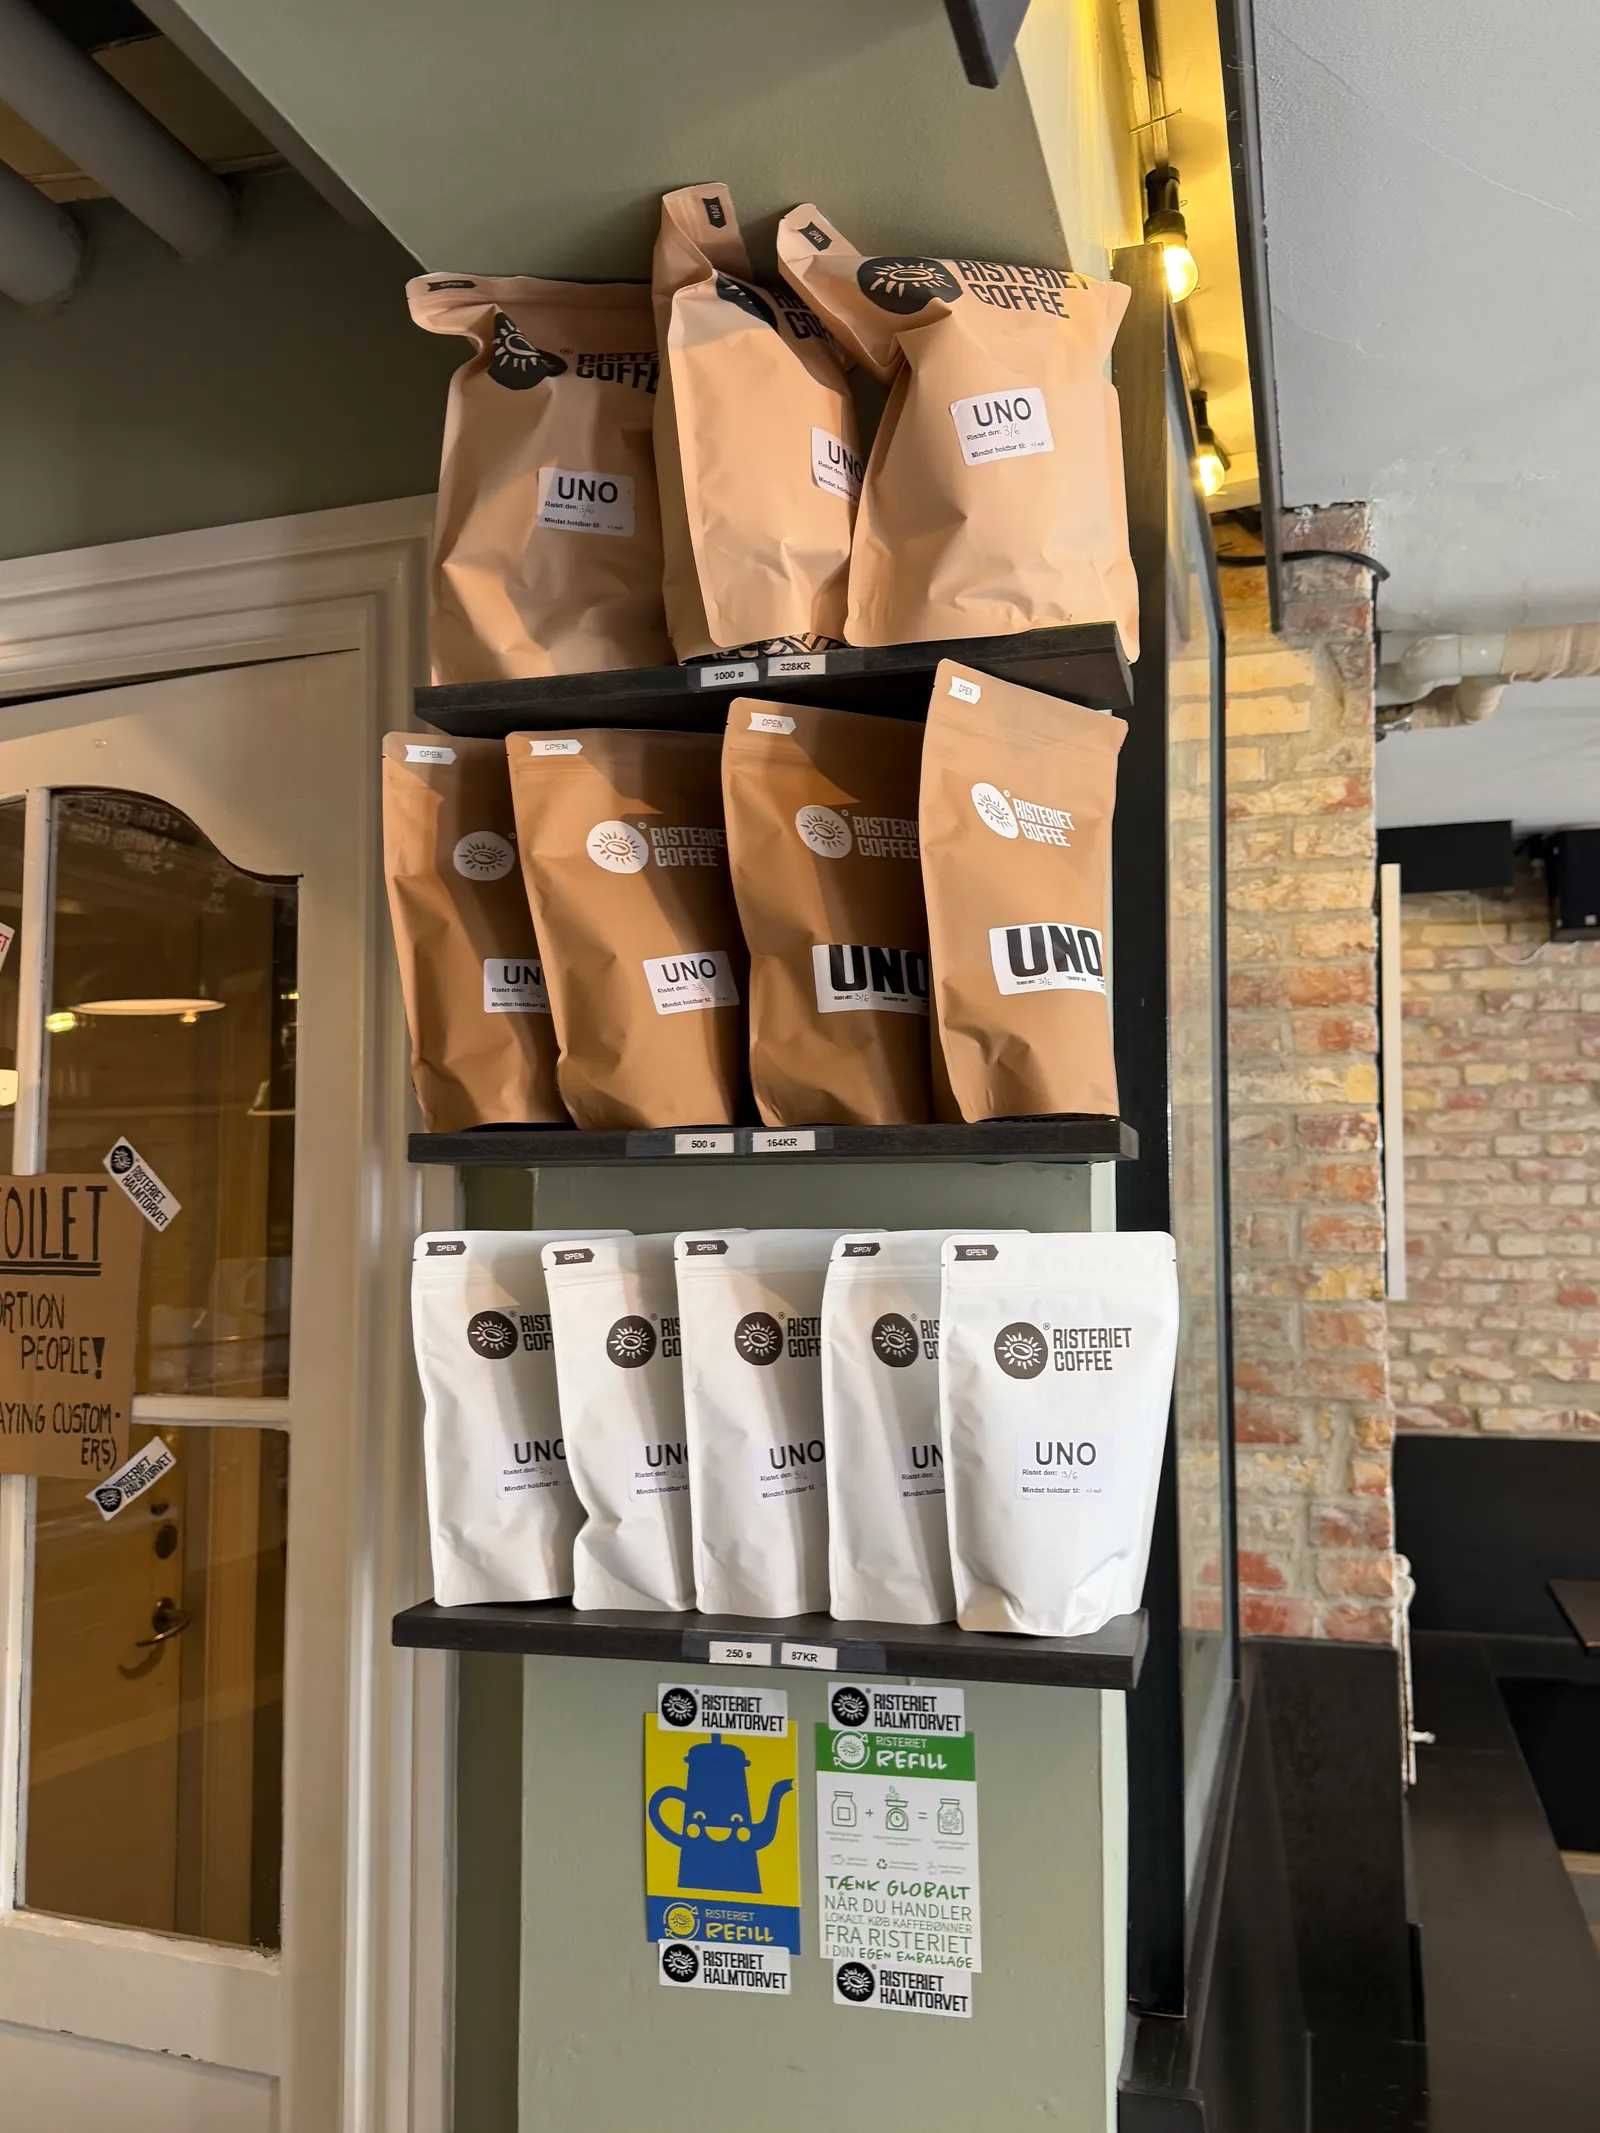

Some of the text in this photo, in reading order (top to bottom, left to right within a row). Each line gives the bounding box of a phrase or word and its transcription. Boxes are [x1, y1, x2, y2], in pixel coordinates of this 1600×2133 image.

[808, 230, 825, 243] OPEN
[968, 283, 1070, 319] COFFEE
[973, 397, 1032, 427] UNO
[1002, 423, 1020, 438] 3/6
[828, 440, 863, 483] UNO
[558, 476, 618, 504] UNO
[713, 671, 736, 681] 1000
[779, 662, 811, 672] 328KR
[959, 684, 974, 697] OPEN
[761, 718, 784, 729] OPEN
[419, 750, 443, 759] OPEN
[544, 743, 569, 751] OPEN
[1012, 797, 1076, 831] RISTERIET
[1019, 820, 1072, 847] COFFEE
[654, 848, 719, 867] COFFEE
[857, 837, 920, 860] COFFEE
[1005, 925, 1104, 978] UNO
[661, 958, 717, 983] UNO
[828, 944, 930, 1000] UNO
[854, 992, 870, 1003] 3/6
[690, 1140, 708, 1149] 500
[766, 1137, 798, 1148] 164KR
[130, 1164, 167, 1204] RISTERIET
[121, 1174, 170, 1227] HALMTORVET
[0, 1185, 108, 1261] OILET
[436, 1243, 458, 1252] OPEN
[563, 1252, 586, 1261] OPEN
[696, 1243, 719, 1252] OPEN
[852, 1245, 873, 1254] OPEN
[965, 1248, 989, 1257] OPEN
[1052, 1327, 1132, 1350] RISTERIET
[20, 1335, 106, 1380] PEOPLE!
[1053, 1350, 1113, 1372] COFFEE
[81, 1437, 118, 1472] ERS)
[645, 1443, 689, 1468] UN
[768, 1440, 826, 1470] UNO
[1035, 1441, 1097, 1466] UNO
[1022, 1468, 1042, 1476] Ristet
[1061, 1470, 1078, 1480] 3/6
[1022, 1486, 1045, 1494] Mindst
[1046, 1486, 1071, 1494] holdbar
[726, 1648, 743, 1658] 250
[701, 1694, 762, 1713] RISTERIET
[873, 1693, 937, 1712] RISTERIET
[701, 1712, 785, 1732] HALMTORVET
[874, 1711, 962, 1732] HALMTORVET
[876, 1736, 928, 1749] RISTERIET
[876, 1750, 948, 1770] REFILL
[825, 1875, 971, 1900] TÆNK GLOBALT
[704, 1908, 756, 1922] RISTERIET
[824, 1891, 972, 1922] NÅR DU HANDLER
[705, 1922, 774, 1943] REFILL
[867, 1916, 891, 1927] KØB
[892, 1917, 973, 1935] KAFFEBØNNER
[825, 1924, 973, 1955] FRA RISTERIET
[702, 1950, 765, 1970] RISTERIET
[832, 1945, 855, 1958] DIN
[859, 1948, 892, 1960] EGEN
[896, 1952, 973, 1969] EMBALLAGE
[703, 1968, 788, 1990] HALMTORVET
[879, 1969, 944, 1992] RISTERIET
[879, 1987, 969, 2013] HALMTORVET
